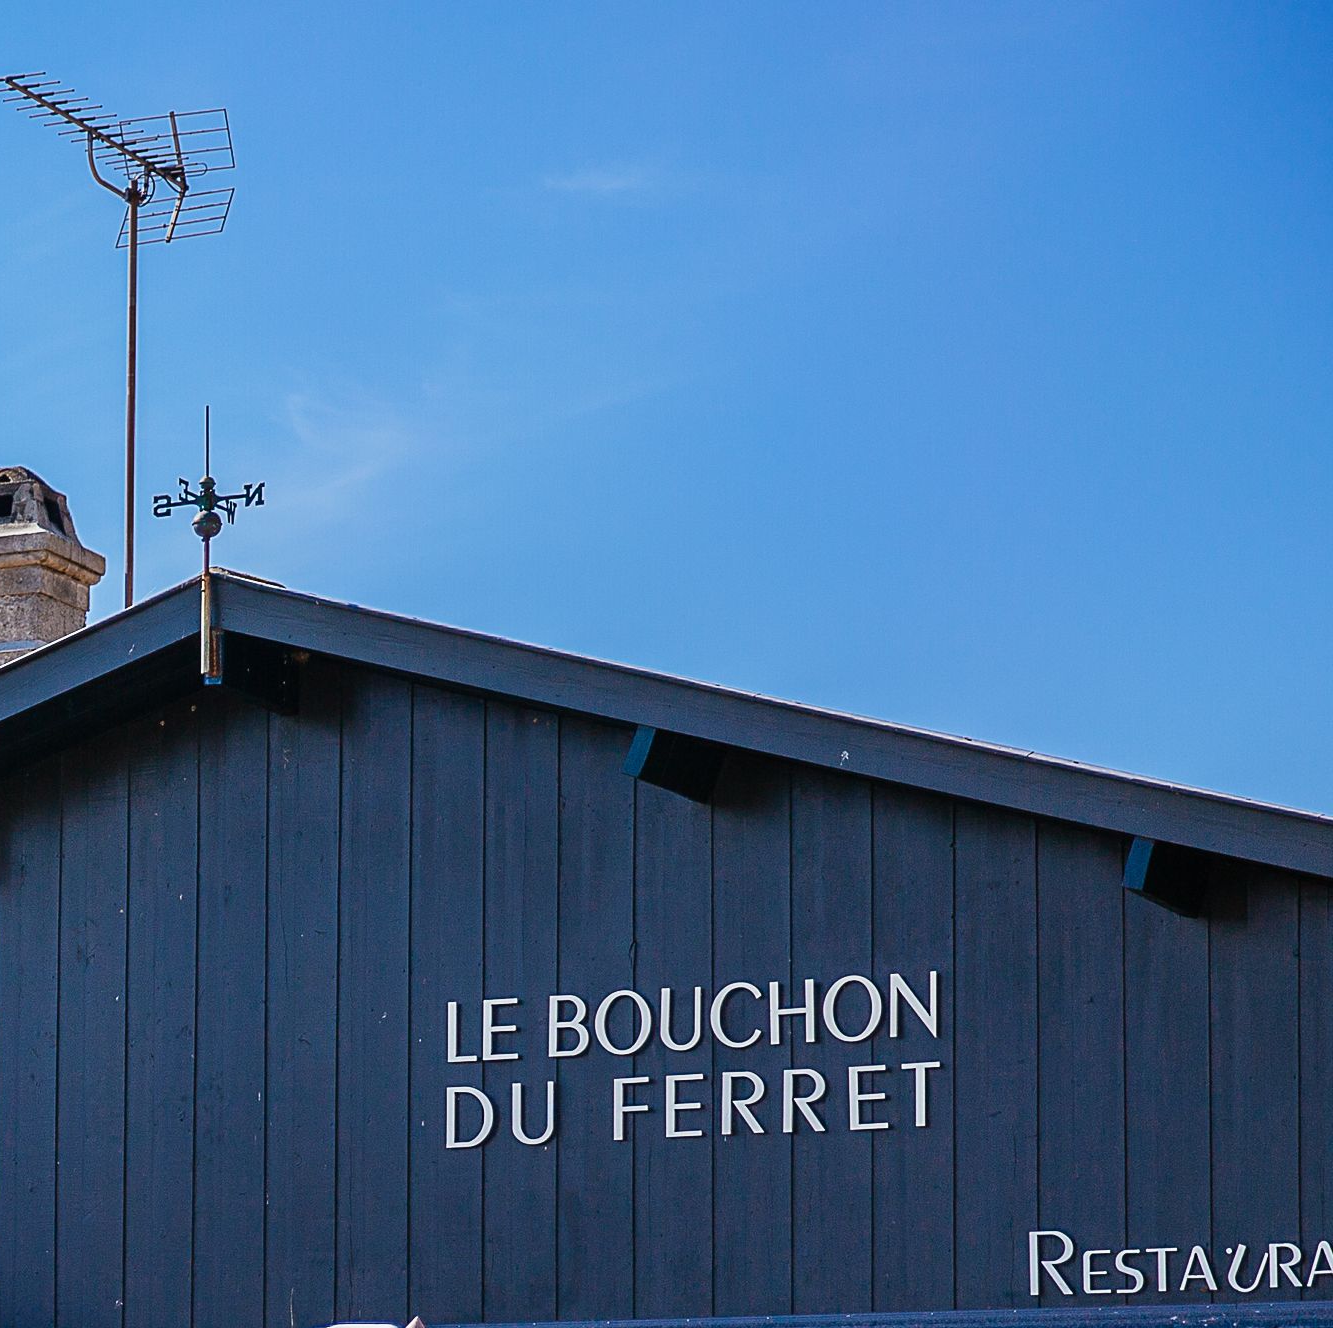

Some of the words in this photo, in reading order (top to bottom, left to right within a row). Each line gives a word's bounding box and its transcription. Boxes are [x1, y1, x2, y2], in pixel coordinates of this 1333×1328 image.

[446, 997, 522, 1064] LE
[547, 970, 939, 1058] BOUCHON
[444, 1081, 555, 1149] DU
[612, 1060, 942, 1142] FERRET
